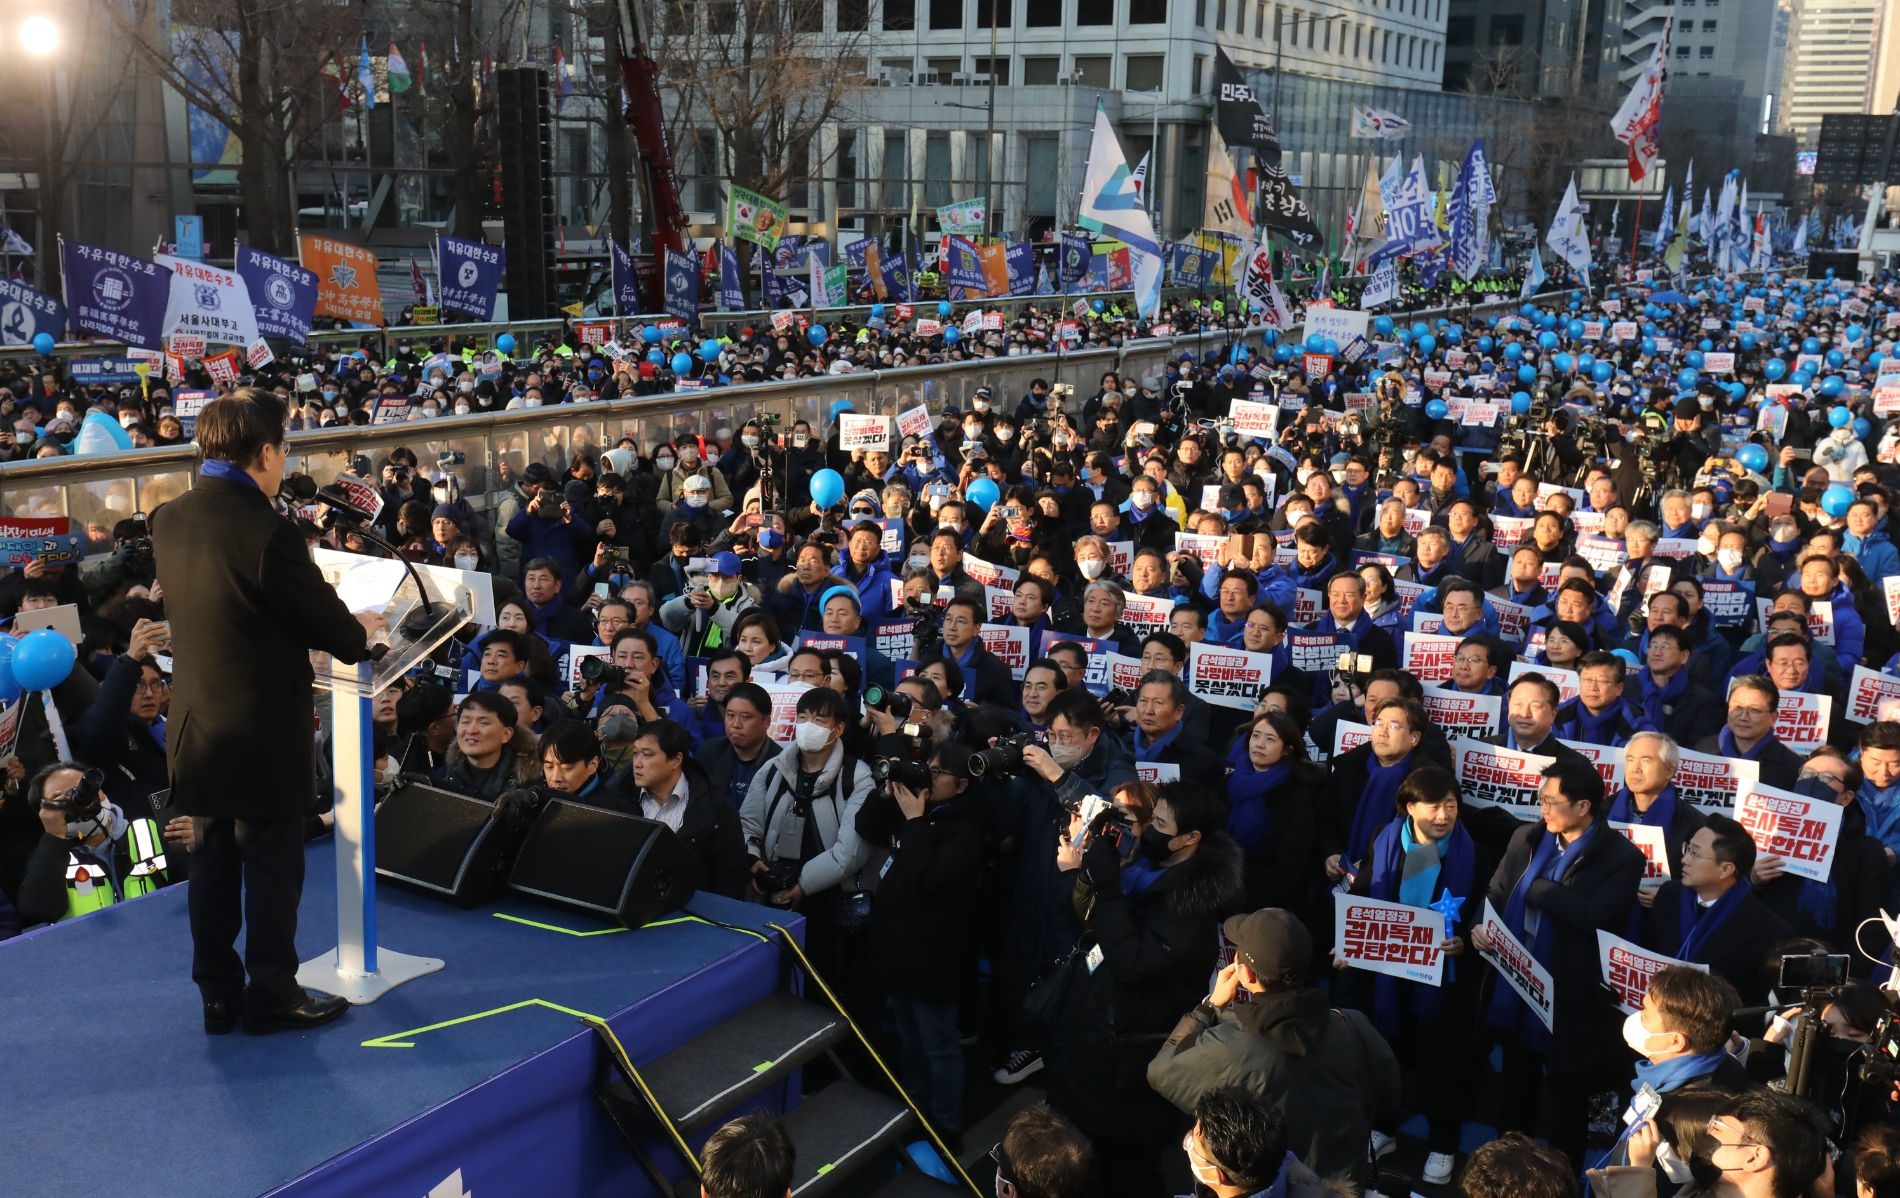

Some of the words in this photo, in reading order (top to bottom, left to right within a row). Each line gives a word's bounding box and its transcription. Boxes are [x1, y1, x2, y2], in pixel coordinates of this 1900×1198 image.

[314, 239, 374, 264] 자유대한수호
[447, 240, 499, 264] 자유대한수호
[77, 244, 156, 276] 자유대한수호
[173, 262, 235, 287] 자유대한수호
[250, 252, 311, 287] 자유대한수호
[180, 313, 238, 332] 서울사대부고
[116, 330, 146, 345] 고교연합
[71, 362, 100, 374] 이재명
[1233, 412, 1271, 422] 검사독재
[844, 426, 884, 436] 난방비폭탄
[844, 434, 886, 446] 못살겠다!
[1181, 540, 1217, 550] 윤석열정권
[967, 562, 1003, 578] 윤석열정권
[1394, 586, 1423, 596] 석열정권
[1701, 583, 1734, 593] 석열정권
[1126, 600, 1156, 612] 석열정권
[1701, 592, 1747, 605] 생파탄
[1490, 602, 1521, 614] 석열정권
[804, 638, 844, 650] 윤석열정권
[983, 640, 1023, 655] 사독재
[1294, 635, 1334, 646] 윤석열정권
[1413, 641, 1457, 653] 윤석열정권
[1291, 644, 1351, 661] 민생파탄
[1408, 652, 1455, 668] 검사독
[1198, 655, 1248, 668] 윤석열정권
[1196, 666, 1262, 683] 난방비폭탄
[1408, 667, 1454, 682] 규탄한
[1194, 680, 1266, 699] 못살겠다!
[1422, 696, 1471, 711] 윤석열정권
[1467, 751, 1522, 771] 윤석열정권
[1461, 763, 1542, 790] 난방비폭탄
[1460, 778, 1542, 807] 못살겠다
[1746, 792, 1806, 818] 윤석열정권
[1740, 807, 1828, 844] 검사독재
[1351, 907, 1411, 924] 윤석열정권
[1344, 920, 1435, 946] 검사독재
[1490, 922, 1530, 968] 윤석열정권
[1343, 939, 1441, 968] 규탄한다!
[1406, 969, 1433, 982] 더불어민주당
